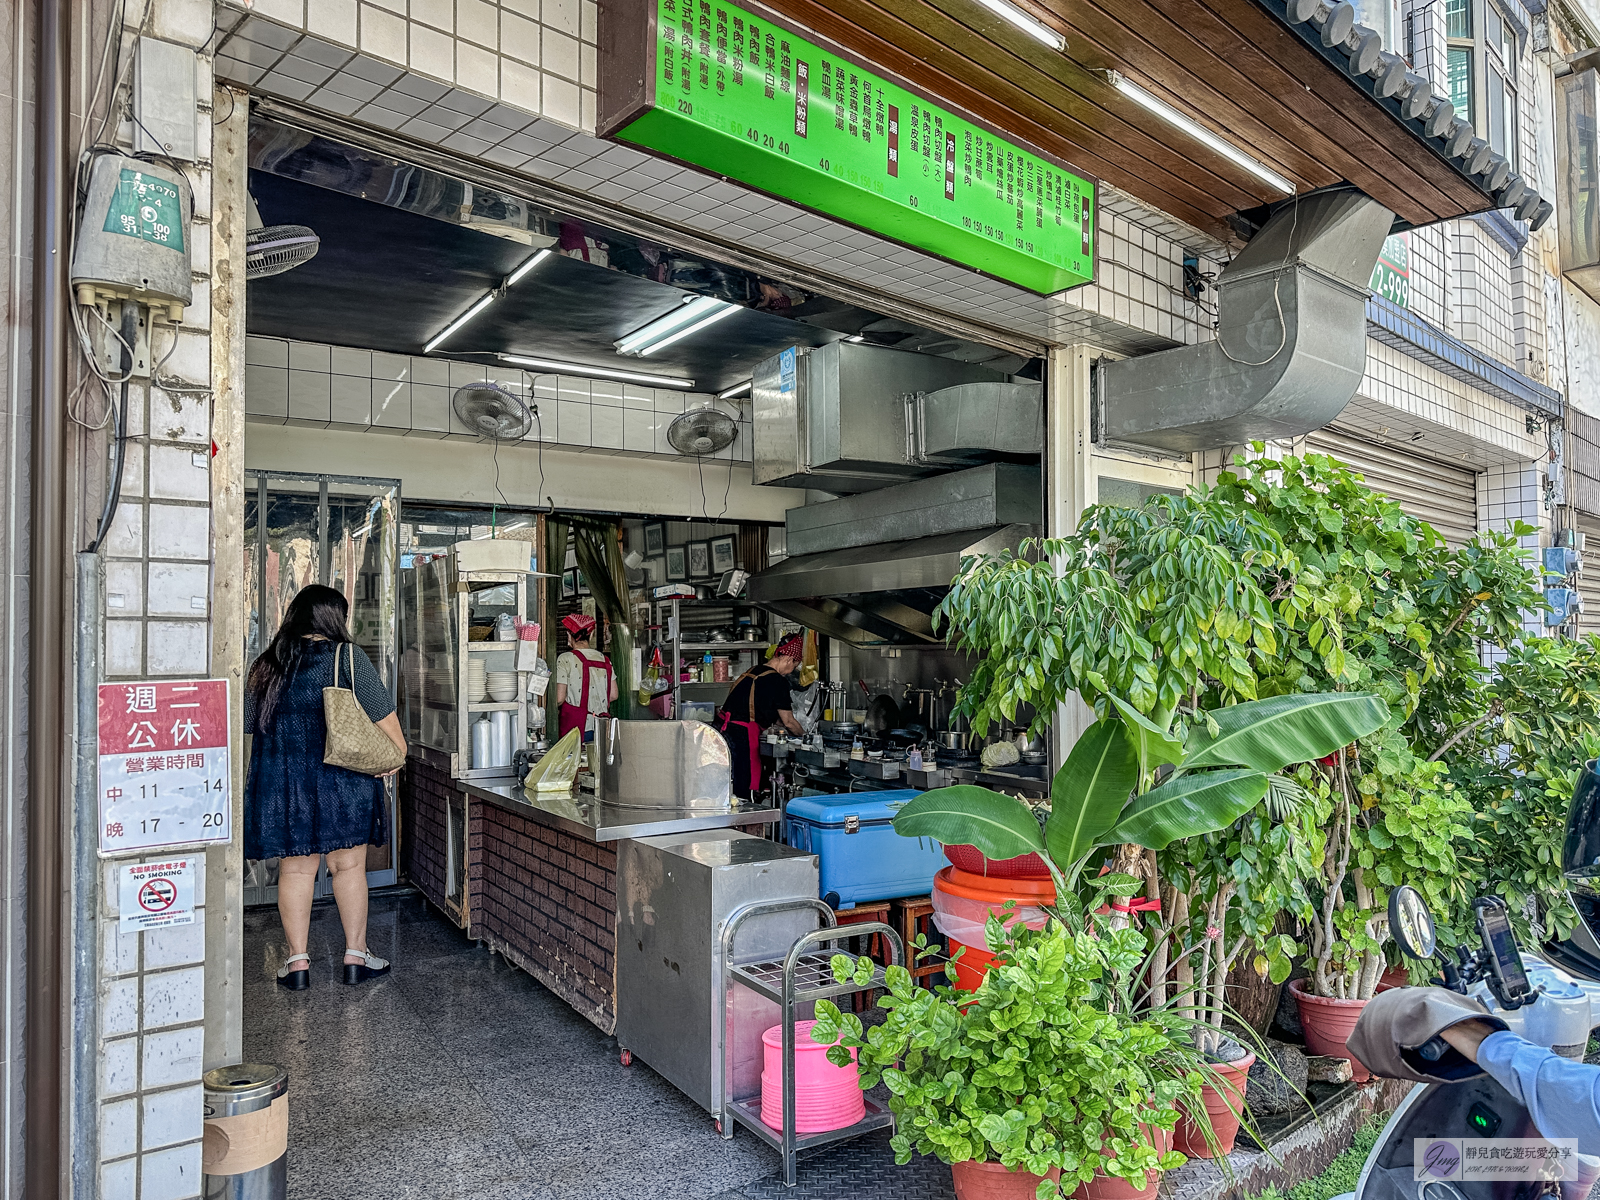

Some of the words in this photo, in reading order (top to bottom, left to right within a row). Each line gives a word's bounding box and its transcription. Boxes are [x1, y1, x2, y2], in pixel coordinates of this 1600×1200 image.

[732, 16, 744, 86] 鴨肉米粉湯
[749, 24, 760, 66] 鴨肉飯
[716, 8, 728, 97] 鴨肉便當(外帶)
[821, 58, 831, 99] 鴨血湯
[678, 99, 693, 116] 220
[730, 121, 742, 136] 60
[747, 128, 758, 142] 40
[763, 134, 774, 148] 20
[779, 140, 790, 155] 40
[888, 120, 898, 163] 湯類
[819, 158, 830, 171] 40
[833, 164, 844, 177] 40
[847, 169, 858, 183] 150
[860, 174, 871, 188] 150
[874, 180, 884, 193] 150
[910, 195, 918, 207] 60
[121, 214, 135, 225] 95
[962, 216, 971, 228] 180
[973, 220, 982, 232] 150
[152, 222, 170, 234] 100
[984, 225, 993, 237] 150
[995, 230, 1004, 241] 150
[1015, 238, 1024, 249] 150
[1026, 242, 1034, 253] 150
[1074, 262, 1080, 272] 30
[126, 686, 200, 714] 週二
[127, 719, 201, 748] 公休
[126, 753, 204, 774] 營業時間
[106, 787, 122, 802] 中
[140, 784, 158, 798] 11
[204, 780, 223, 793] 14
[106, 822, 124, 838] 晚
[140, 818, 161, 834] 17
[202, 812, 224, 828] 20
[148, 870, 182, 878] SMOKING
